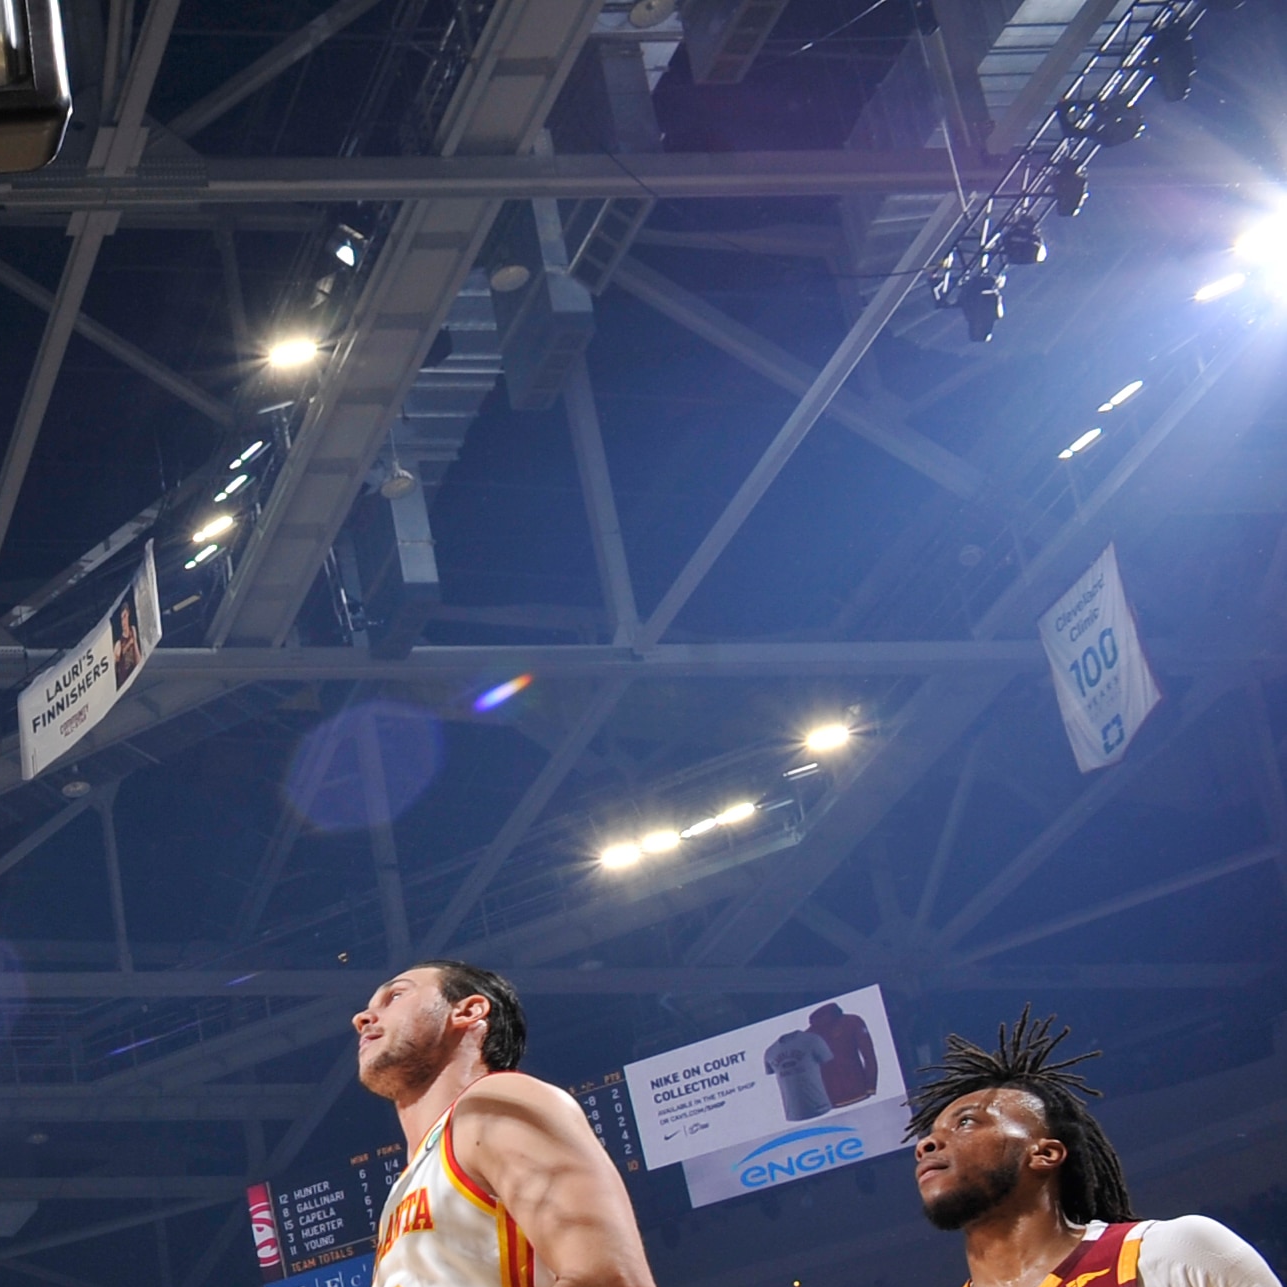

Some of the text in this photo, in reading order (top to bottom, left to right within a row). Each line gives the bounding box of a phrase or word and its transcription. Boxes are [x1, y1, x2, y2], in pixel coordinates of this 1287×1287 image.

[1055, 573, 1105, 633] Cleveland
[1069, 607, 1100, 642] Clinic
[45, 648, 95, 703] LAURI'S
[1069, 627, 1118, 698] 100
[31, 656, 110, 734] FINNISHERS
[650, 1051, 747, 1092] NIKE ON COURT
[653, 1072, 731, 1104] COLLECTION
[293, 1159, 399, 1200] HUNTER 1/4
[296, 1190, 345, 1214] GALLINARI
[298, 1207, 336, 1226] CAPELA
[301, 1218, 344, 1239] HUERTER
[303, 1234, 335, 1252] YOUNG
[291, 1246, 355, 1273] TEAM TOTALS
